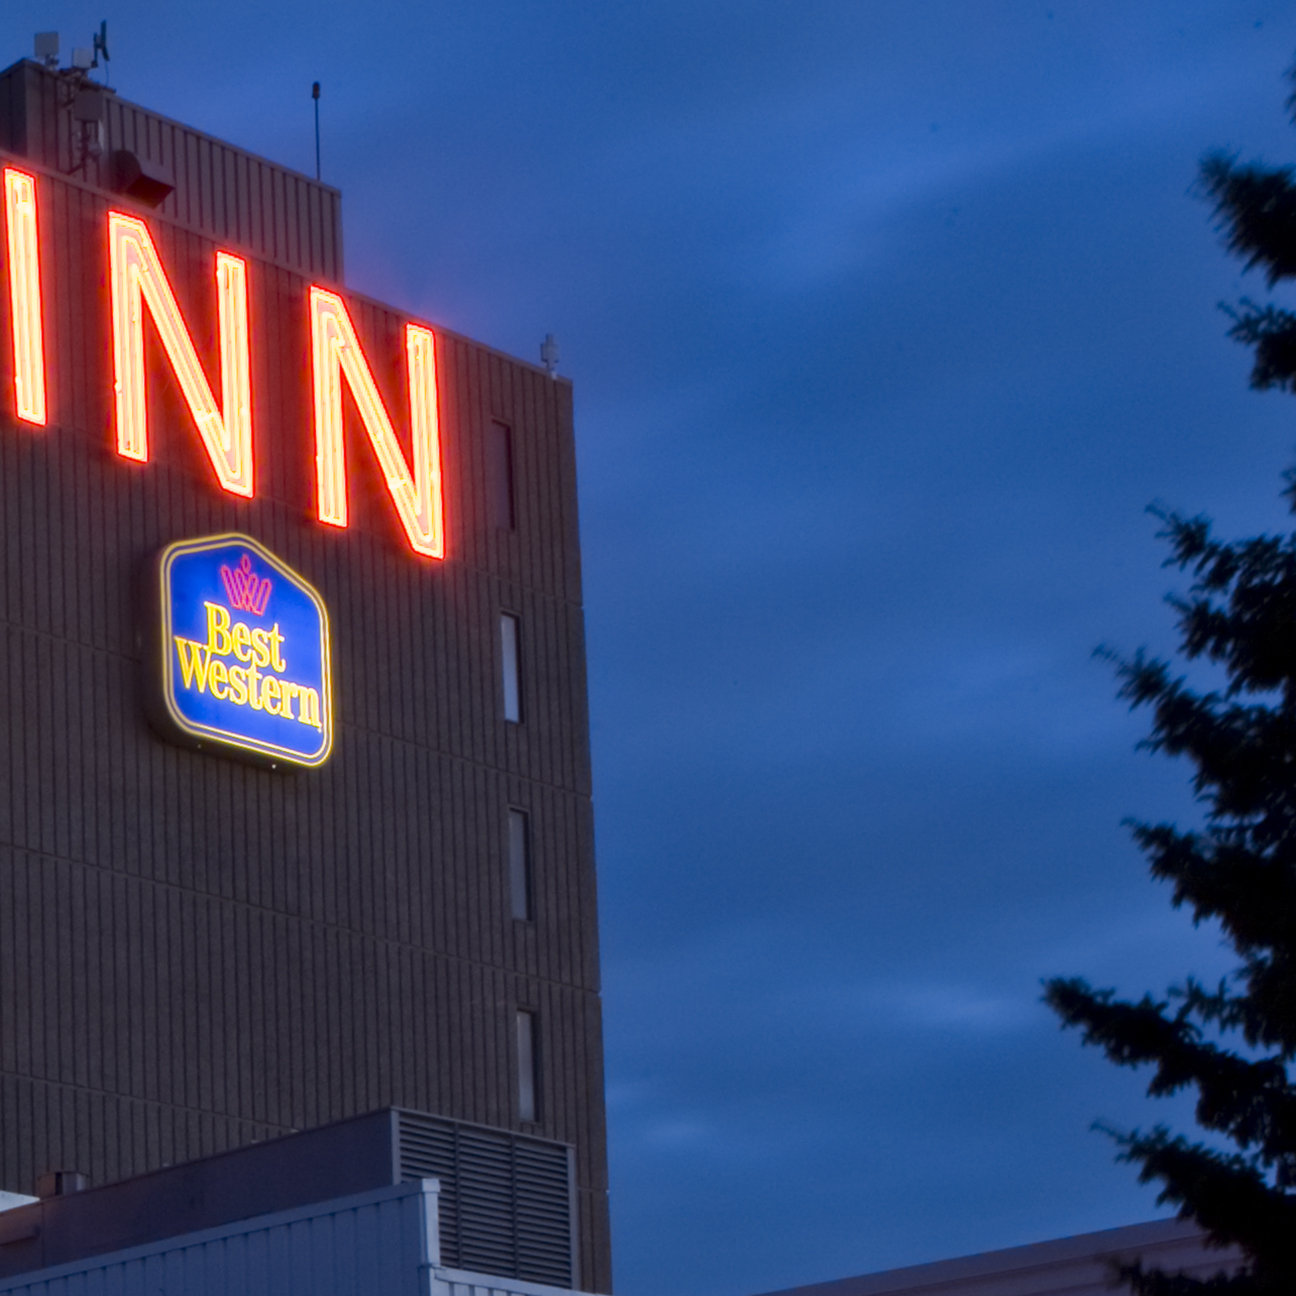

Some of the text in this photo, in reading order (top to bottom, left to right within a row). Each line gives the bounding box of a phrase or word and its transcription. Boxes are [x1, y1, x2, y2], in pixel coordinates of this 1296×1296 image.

[3, 167, 445, 560] INN
[173, 635, 323, 730] Western
[204, 601, 286, 673] Best
